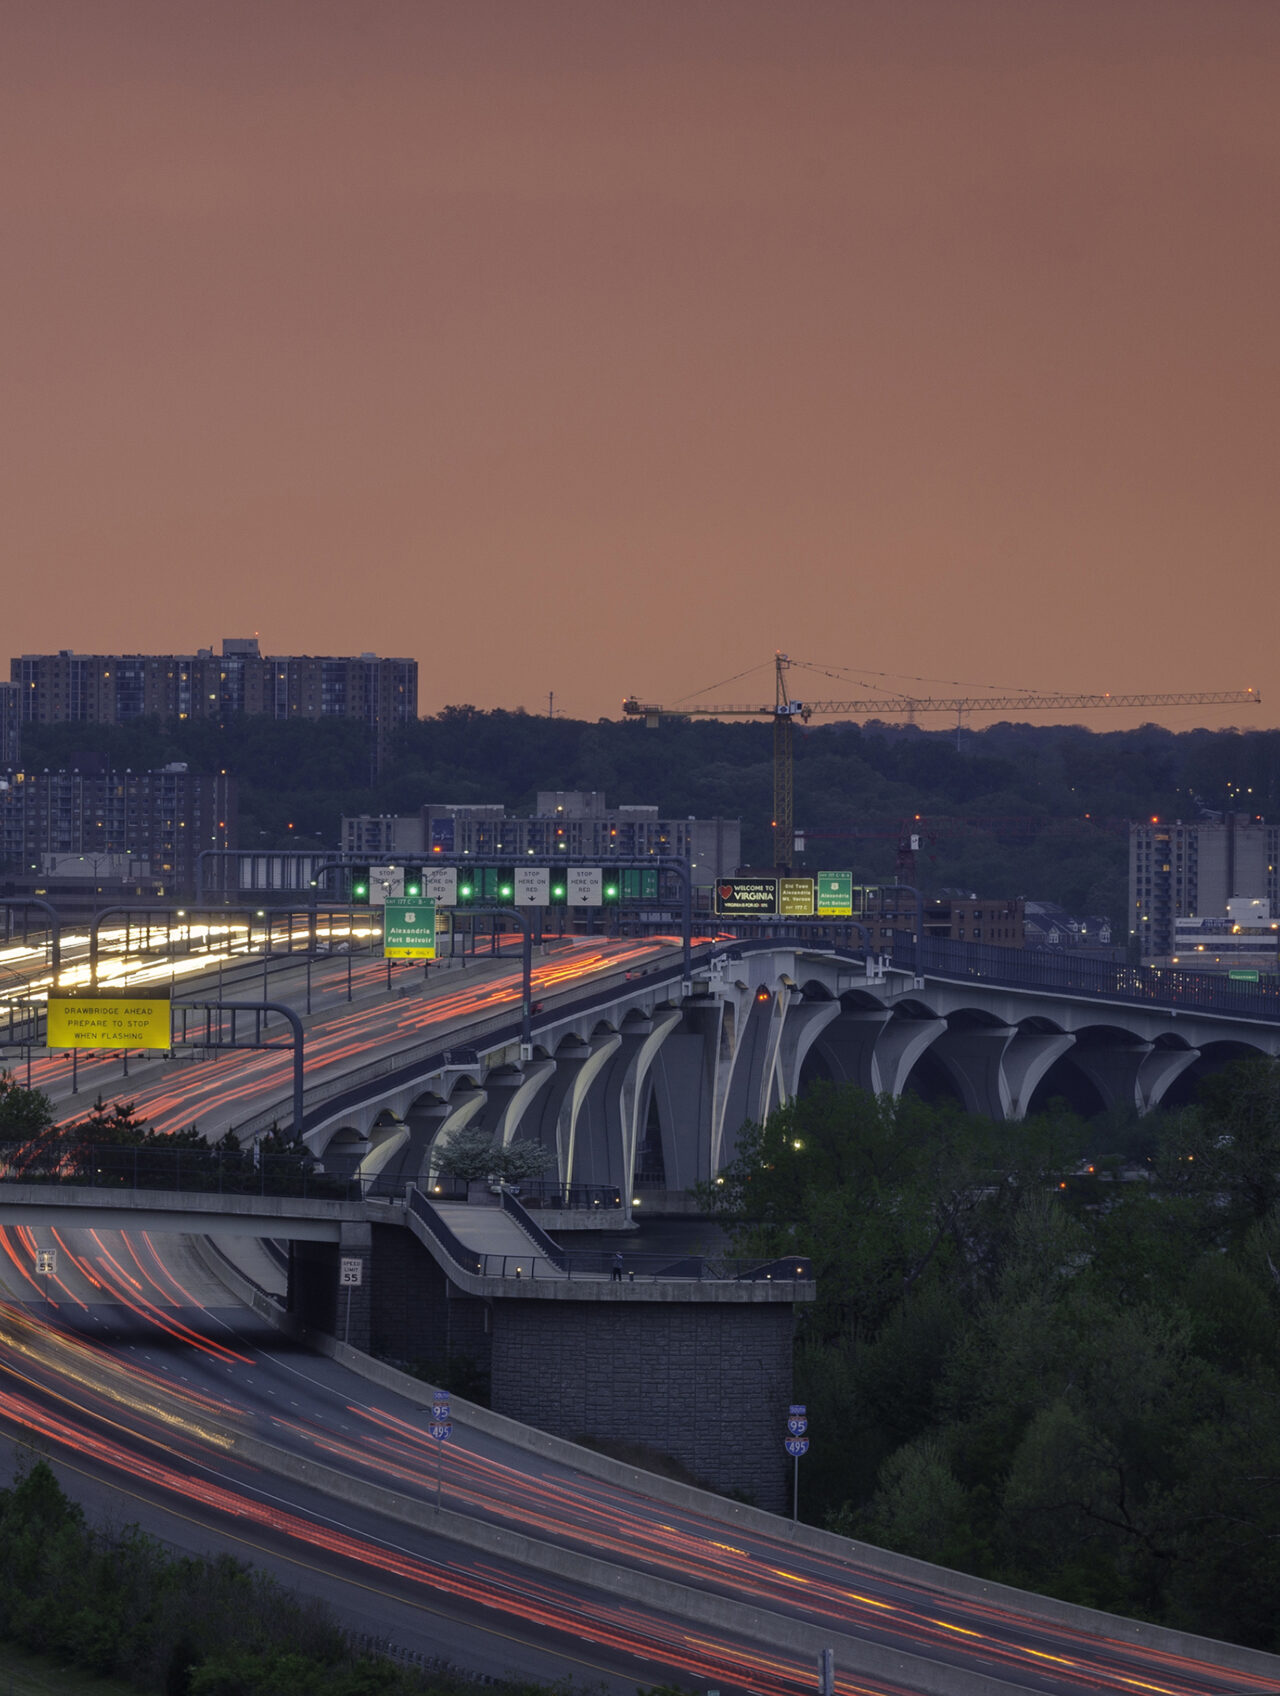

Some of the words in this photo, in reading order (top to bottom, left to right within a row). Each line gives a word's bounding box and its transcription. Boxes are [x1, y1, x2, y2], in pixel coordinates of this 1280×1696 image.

[733, 892, 774, 901] VIRGINIA
[64, 1007, 119, 1015] DRAWBRIDGE
[124, 1007, 153, 1015] AHEAD
[39, 1263, 54, 1271] 55
[344, 1273, 358, 1282] 55
[433, 1406, 448, 1417] 95
[790, 1421, 805, 1432] 95
[432, 1426, 449, 1438] 495
[789, 1442, 806, 1453] 495
